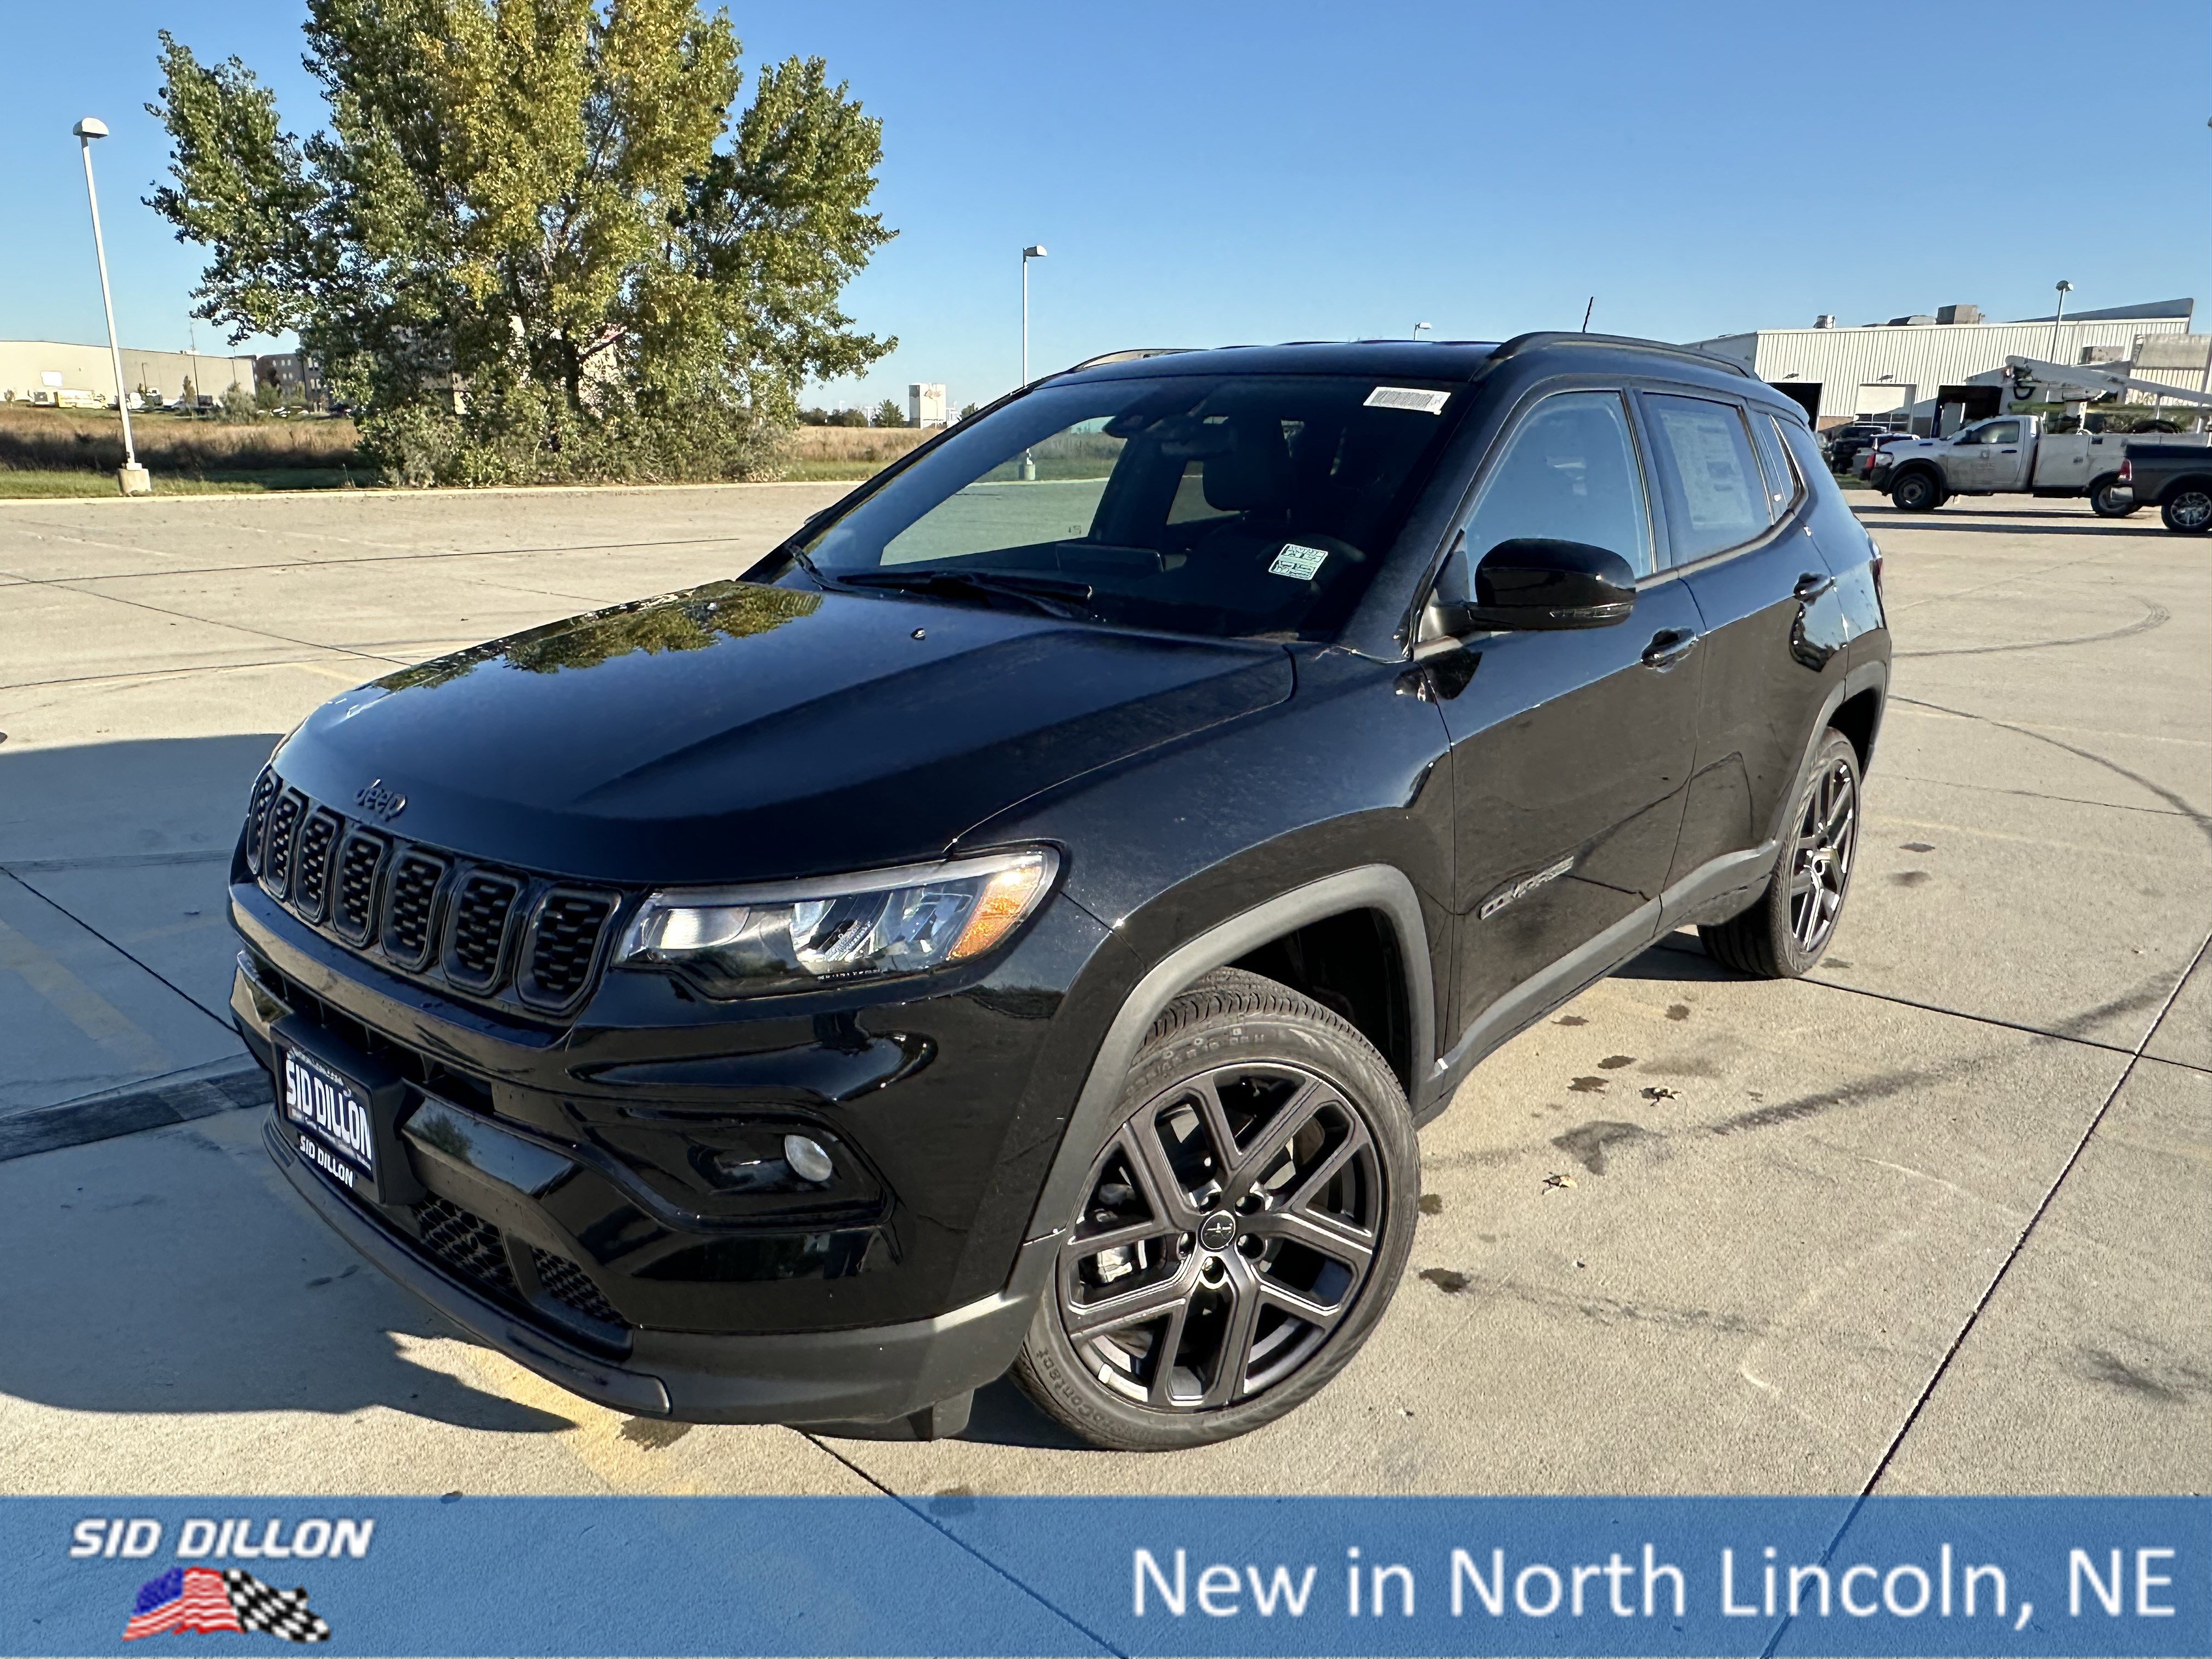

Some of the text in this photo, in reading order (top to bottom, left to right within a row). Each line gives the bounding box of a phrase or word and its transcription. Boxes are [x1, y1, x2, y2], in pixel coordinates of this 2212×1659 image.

[353, 778, 408, 822] Jeep
[286, 1059, 313, 1116] SID
[314, 1076, 371, 1160] DILLON
[300, 1135, 316, 1159] SID
[317, 1147, 353, 1188] DILLON
